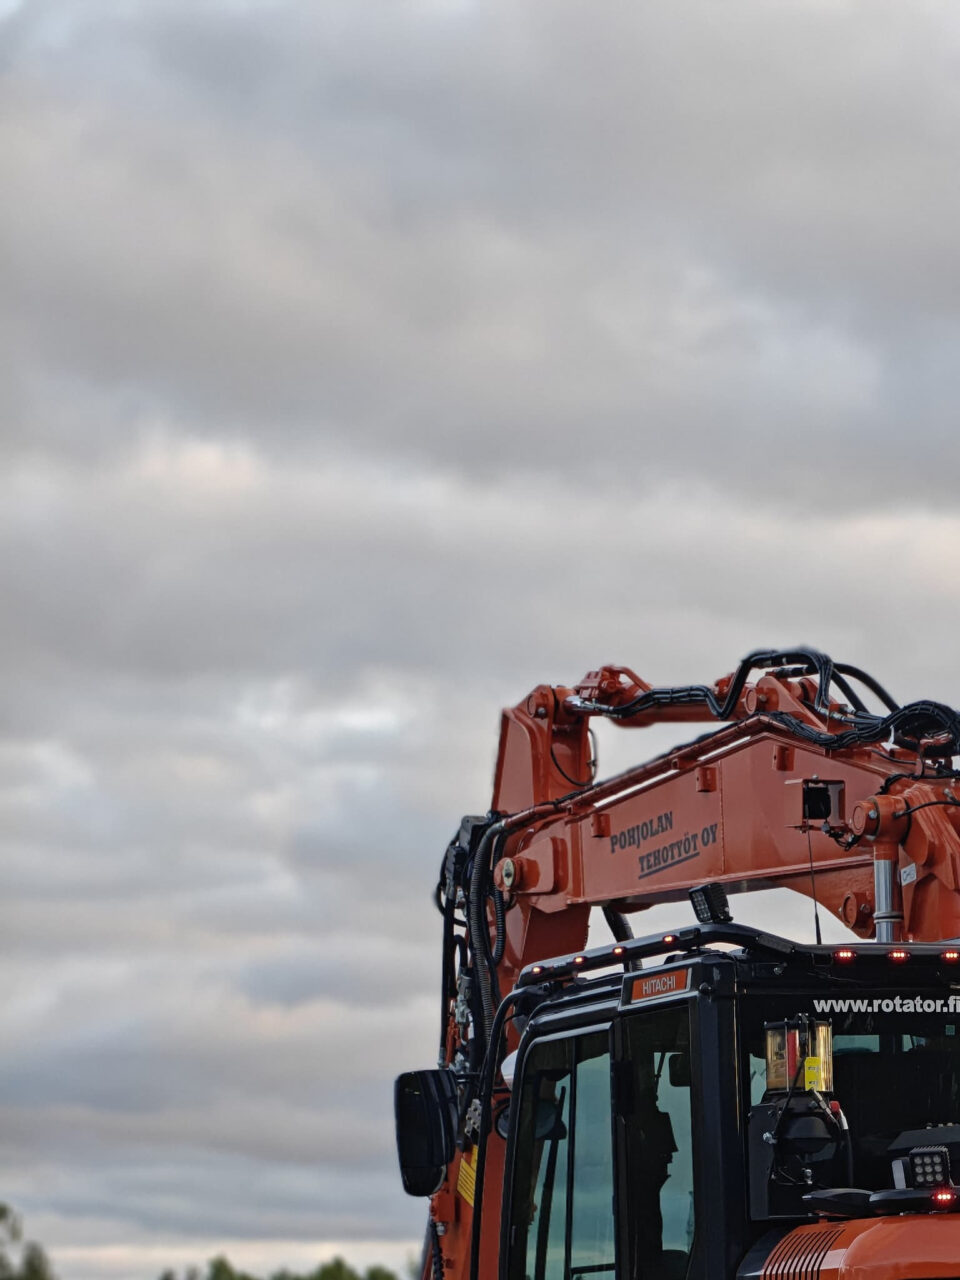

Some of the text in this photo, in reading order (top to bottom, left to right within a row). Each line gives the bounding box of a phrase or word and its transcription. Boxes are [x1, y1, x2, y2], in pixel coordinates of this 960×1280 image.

[610, 811, 673, 854] POHJOLAN
[638, 823, 718, 873] TEHOTYÖT OY
[642, 975, 676, 995] HITACHI
